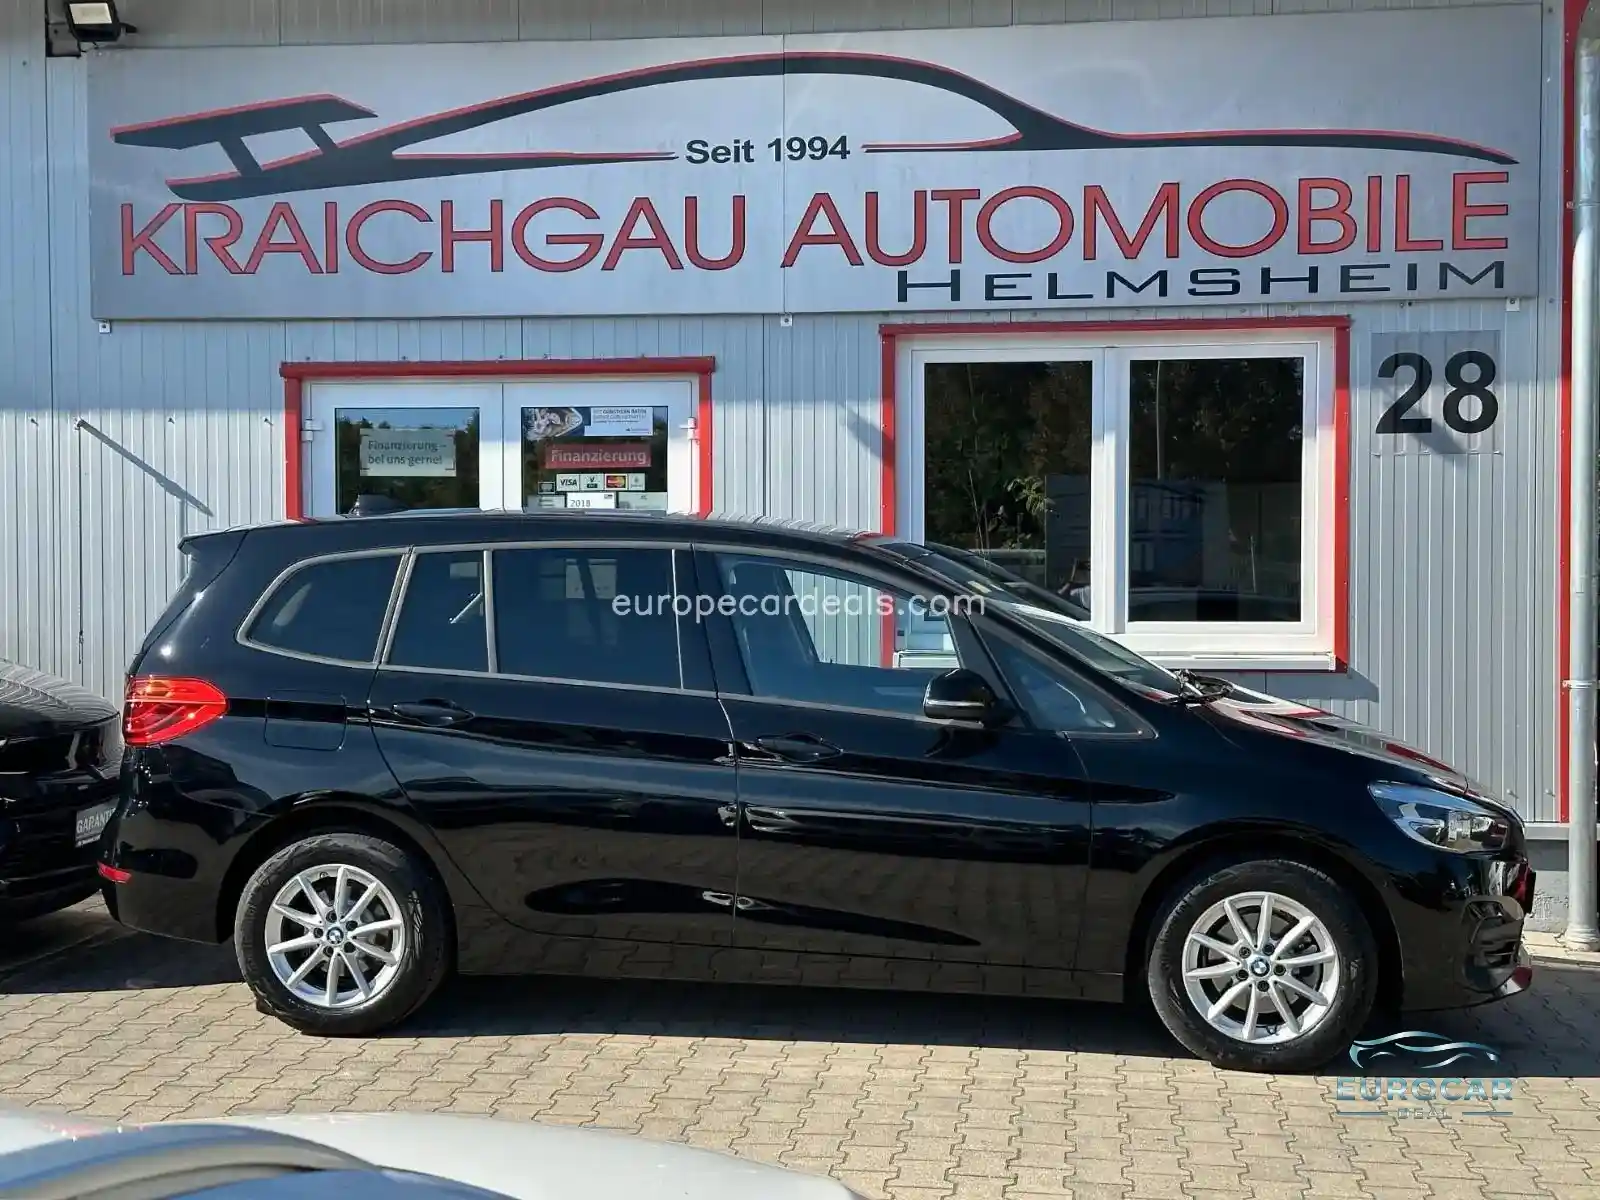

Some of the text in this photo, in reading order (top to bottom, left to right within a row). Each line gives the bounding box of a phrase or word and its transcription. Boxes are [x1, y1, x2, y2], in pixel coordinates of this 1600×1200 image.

[685, 135, 850, 164] Seit 1994
[120, 171, 1510, 275] KRAICHGAU AUTOMOBILE
[897, 259, 1505, 303] HELMSHEIM
[1375, 350, 1499, 435] 28
[386, 456, 405, 464] uns
[551, 449, 647, 465] Finanzierung
